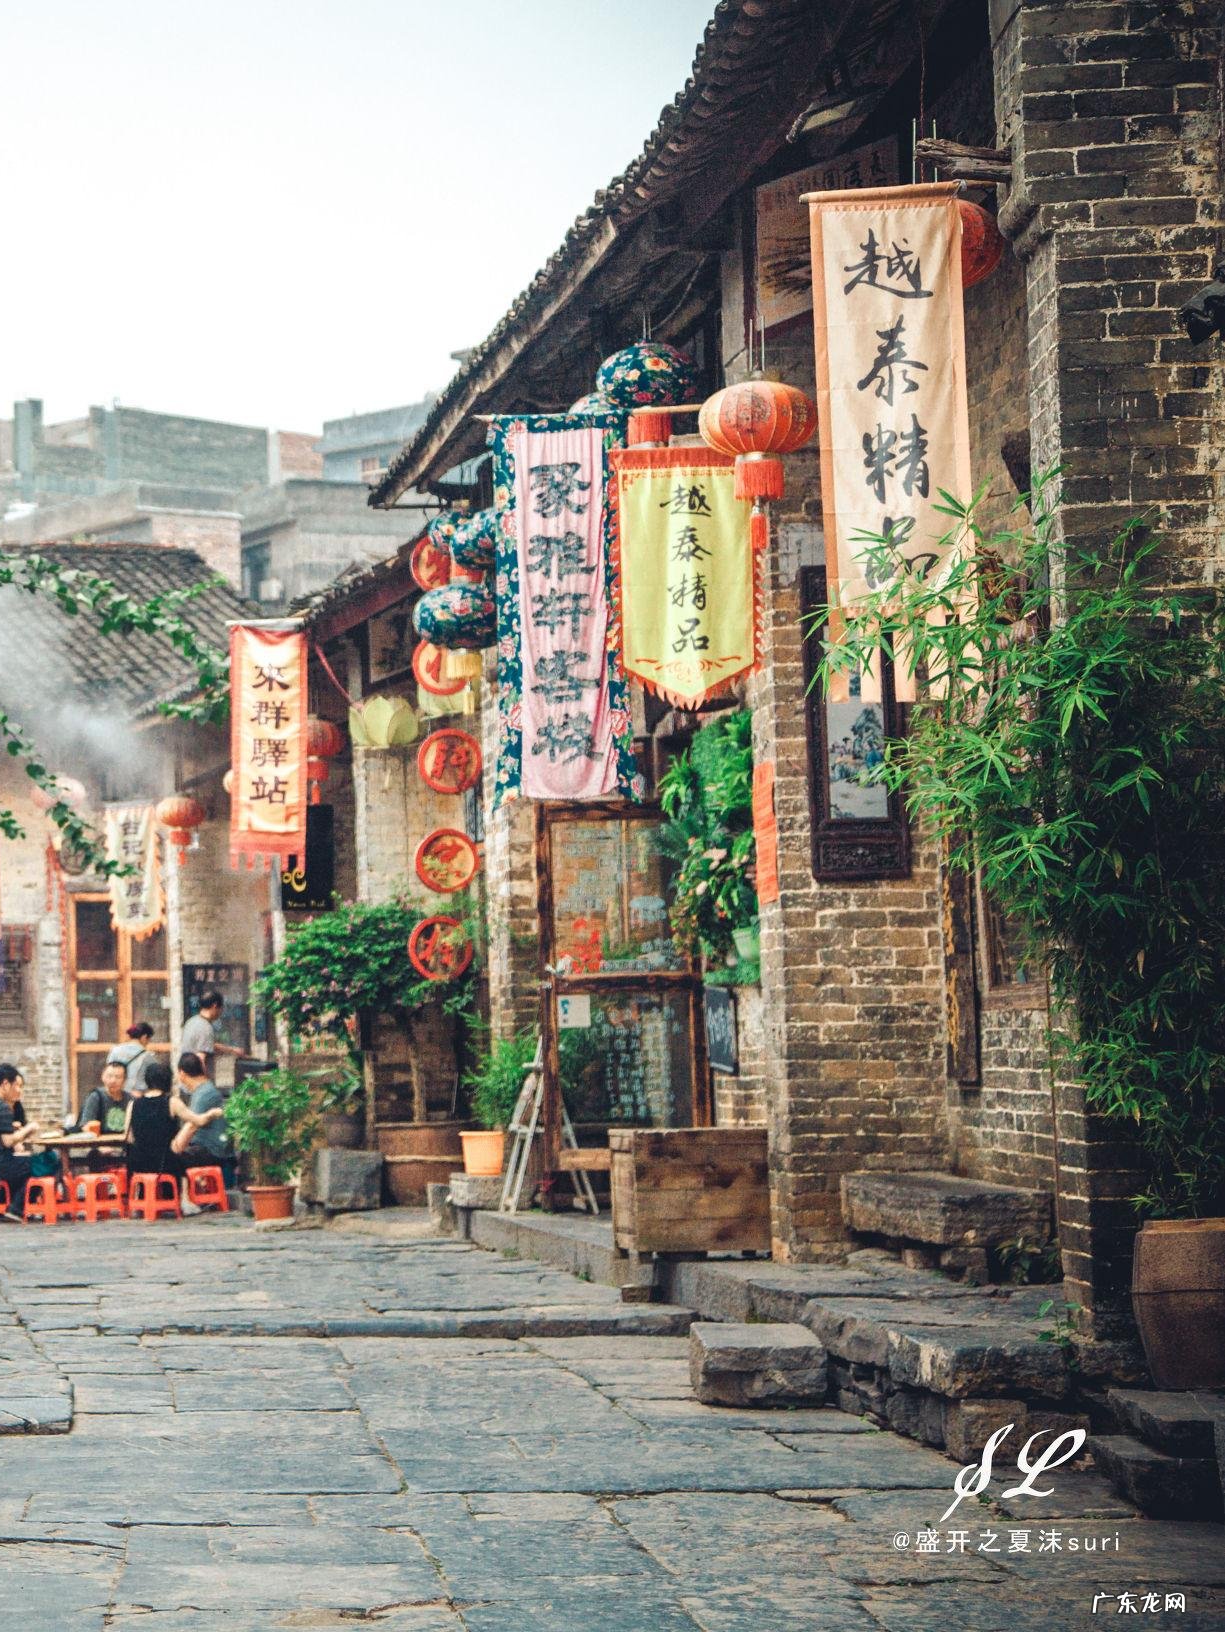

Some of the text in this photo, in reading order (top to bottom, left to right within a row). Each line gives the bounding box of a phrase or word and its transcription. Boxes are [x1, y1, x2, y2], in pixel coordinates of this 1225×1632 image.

[842, 228, 940, 590] 越泰精品
[659, 483, 713, 653] 越泰精品
